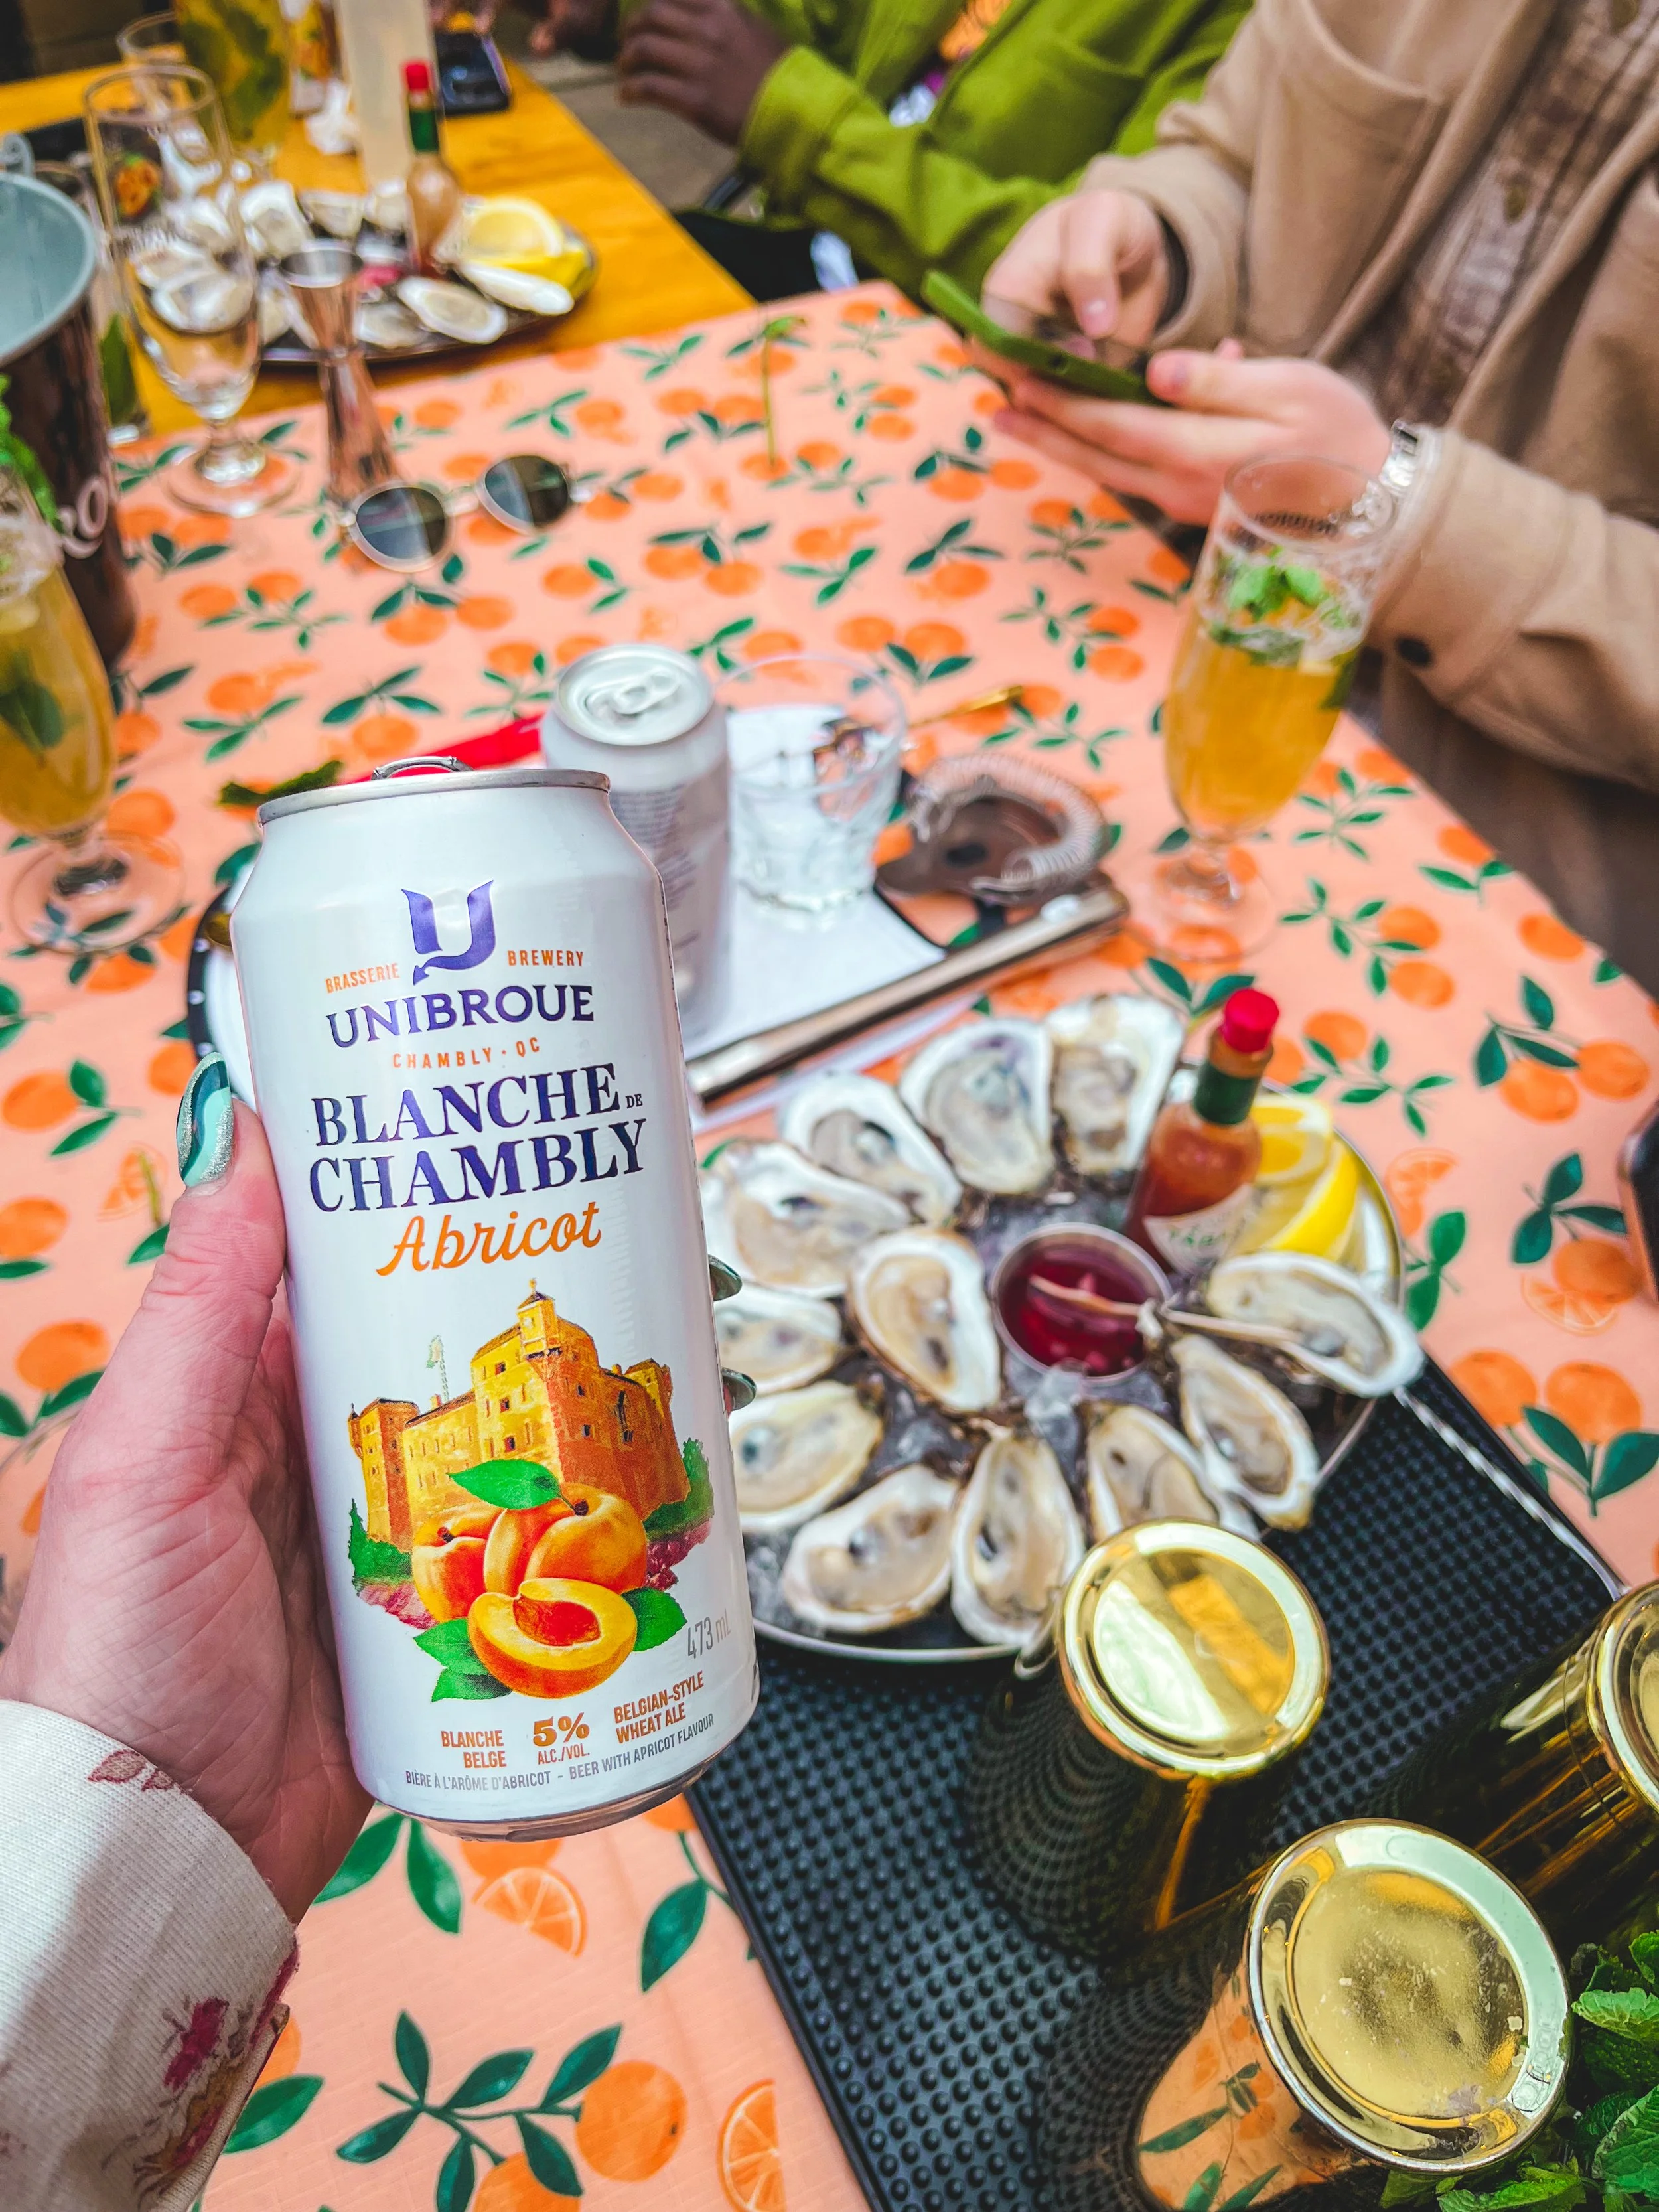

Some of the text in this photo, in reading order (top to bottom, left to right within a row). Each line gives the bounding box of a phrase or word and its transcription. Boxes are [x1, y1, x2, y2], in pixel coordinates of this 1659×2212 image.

[325, 963, 401, 994] BRASSERIE
[508, 950, 584, 967] BREWERY
[326, 985, 595, 1049] UNIBROUE
[393, 1046, 492, 1069] CHAMBLY
[312, 1062, 644, 1147] BLANCHE DE
[309, 1118, 648, 1213] CHAMBLY
[376, 1201, 602, 1277] Abricot
[687, 1607, 731, 1659] 473 mL
[613, 1670, 705, 1724] BELGIAN-STYLE
[441, 1730, 504, 1748] BLANCHE
[533, 1712, 590, 1747] 5%
[615, 1702, 686, 1744] WHEAT ALE
[405, 1769, 432, 1787] BIÈRE
[434, 1773, 441, 1789] À
[492, 1771, 551, 1790] D'ABRICOT
[569, 1761, 599, 1780] BEER
[601, 1752, 630, 1773] WITH
[634, 1733, 675, 1763] APRICOT
[678, 1713, 714, 1745] FLAVOUR
[463, 1750, 507, 1769] BELGE
[538, 1743, 591, 1765] ALC./VOL.
